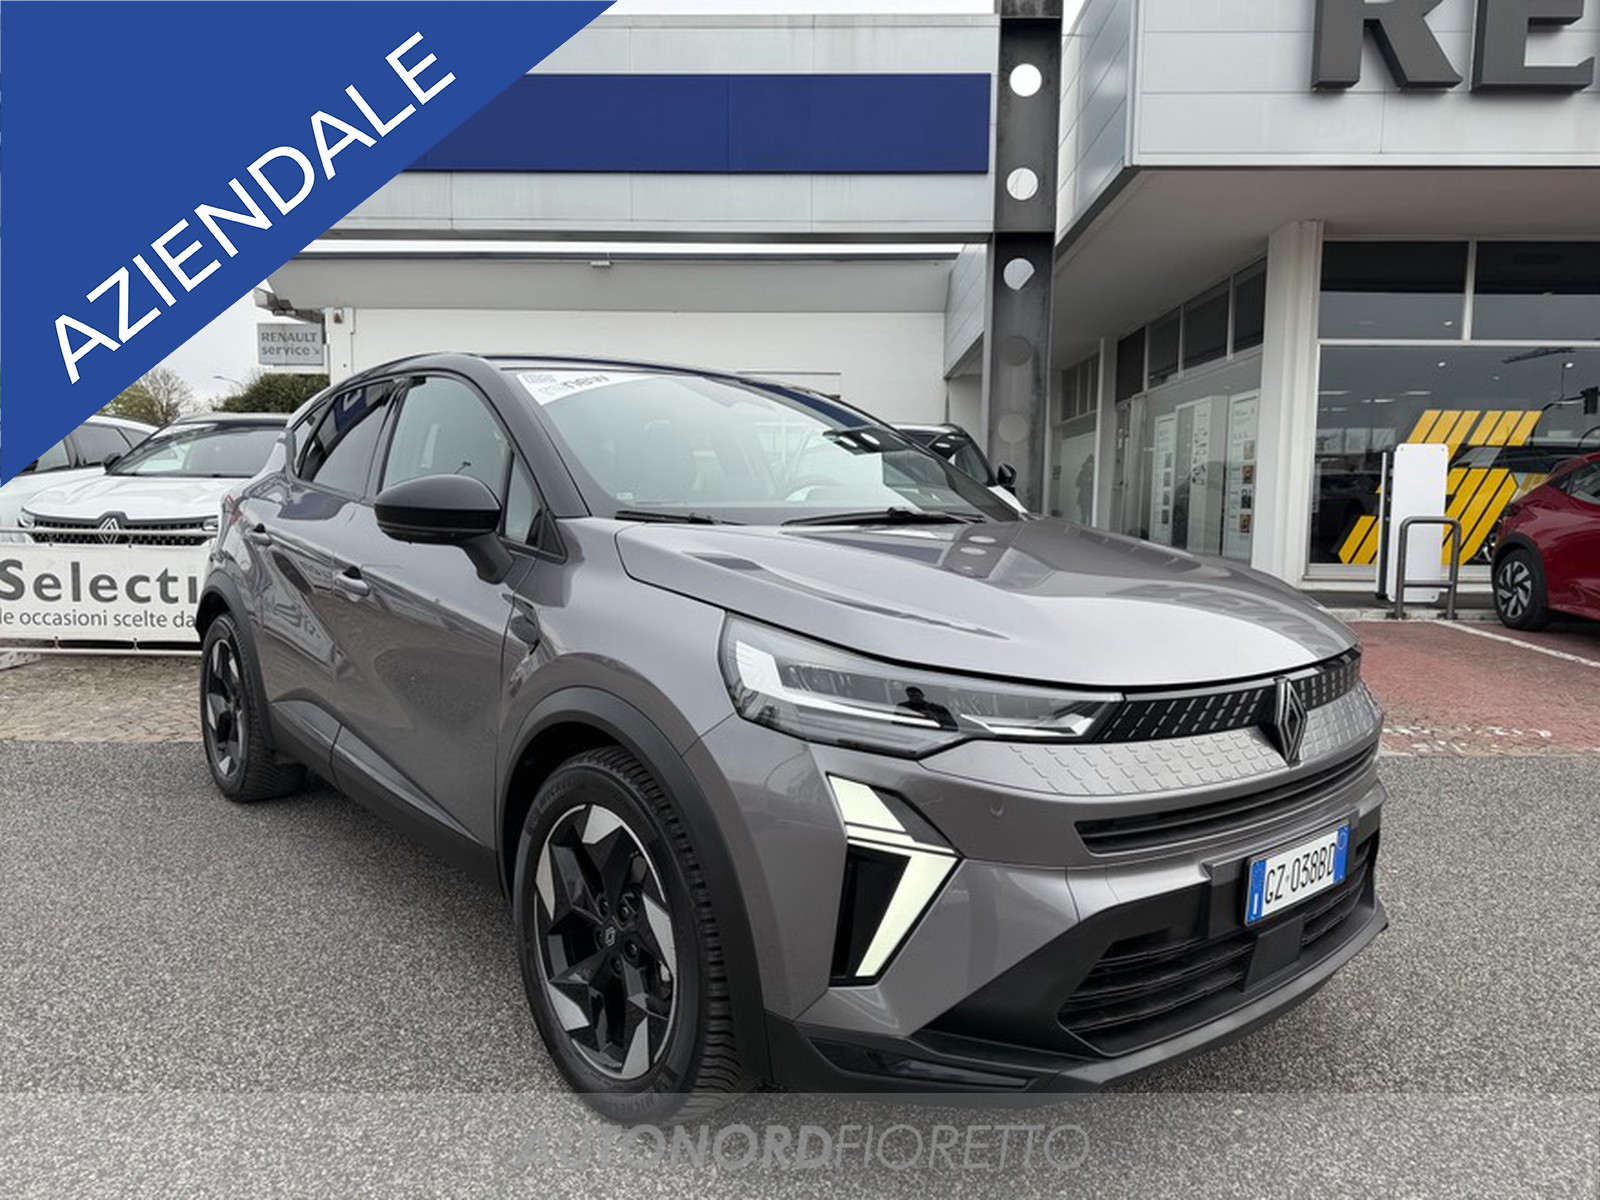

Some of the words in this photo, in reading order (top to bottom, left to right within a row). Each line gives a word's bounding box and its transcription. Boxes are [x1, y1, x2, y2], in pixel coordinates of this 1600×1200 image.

[261, 331, 317, 343] RENAULT
[261, 343, 310, 356] service
[19, 609, 108, 627] occasioni
[113, 609, 168, 628] scelte
[172, 610, 196, 629] da
